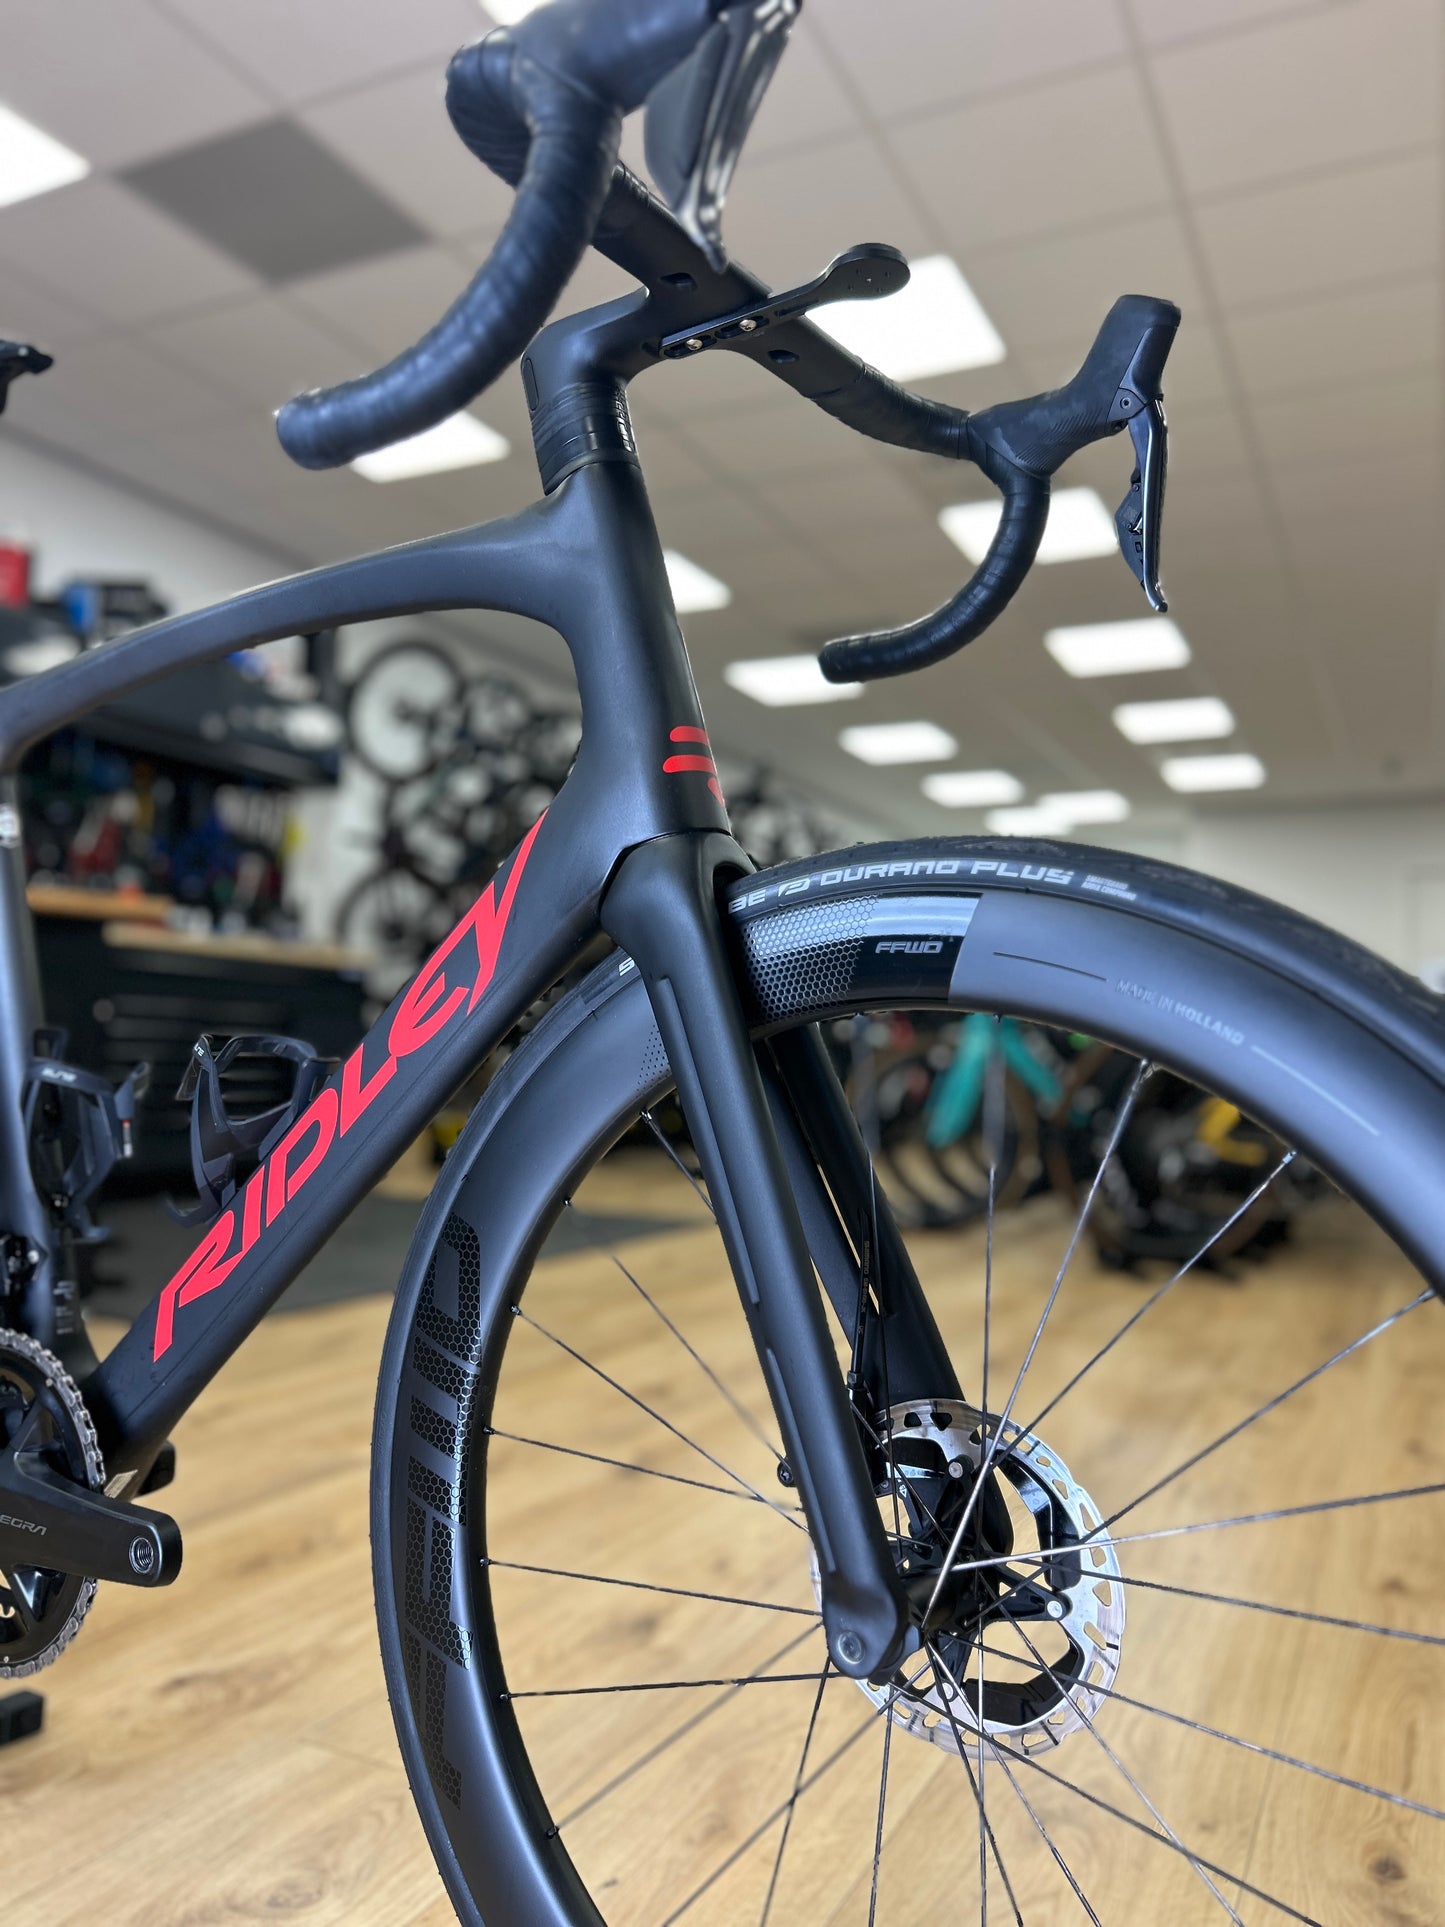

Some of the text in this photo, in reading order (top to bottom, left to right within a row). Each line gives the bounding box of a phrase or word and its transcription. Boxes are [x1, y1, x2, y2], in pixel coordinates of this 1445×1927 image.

[820, 861, 960, 887] DURANO
[970, 860, 1075, 886] PLUS
[875, 940, 944, 954] FFWD
[1174, 1001, 1246, 1047] HOLLAND
[153, 807, 550, 1363] RIDLEY
